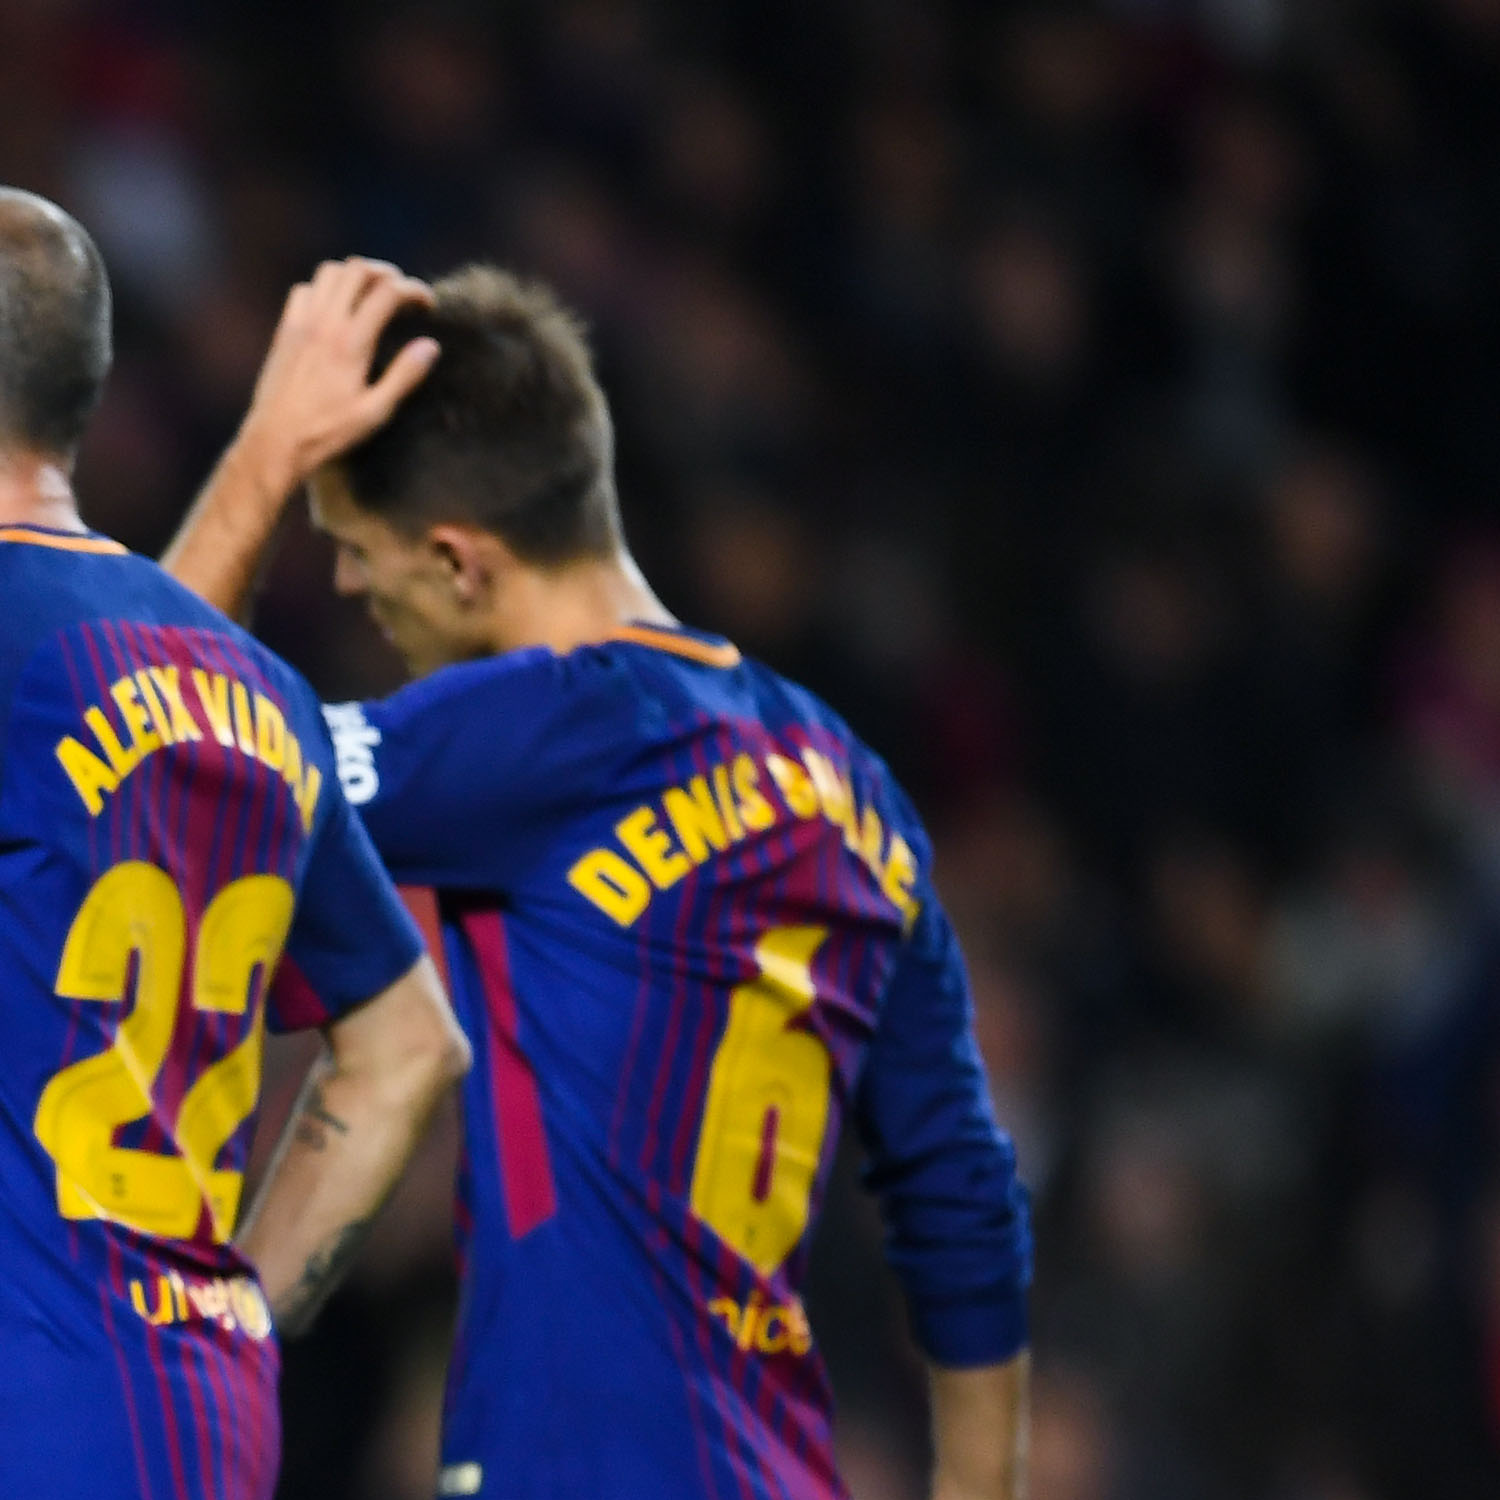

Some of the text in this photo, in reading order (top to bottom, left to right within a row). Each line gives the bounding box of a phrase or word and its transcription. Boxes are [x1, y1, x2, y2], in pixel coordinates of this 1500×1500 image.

[55, 664, 204, 818] ALEIX
[567, 752, 776, 928] DENIS
[34, 859, 295, 1243] 22
[690, 925, 830, 1277] 6
